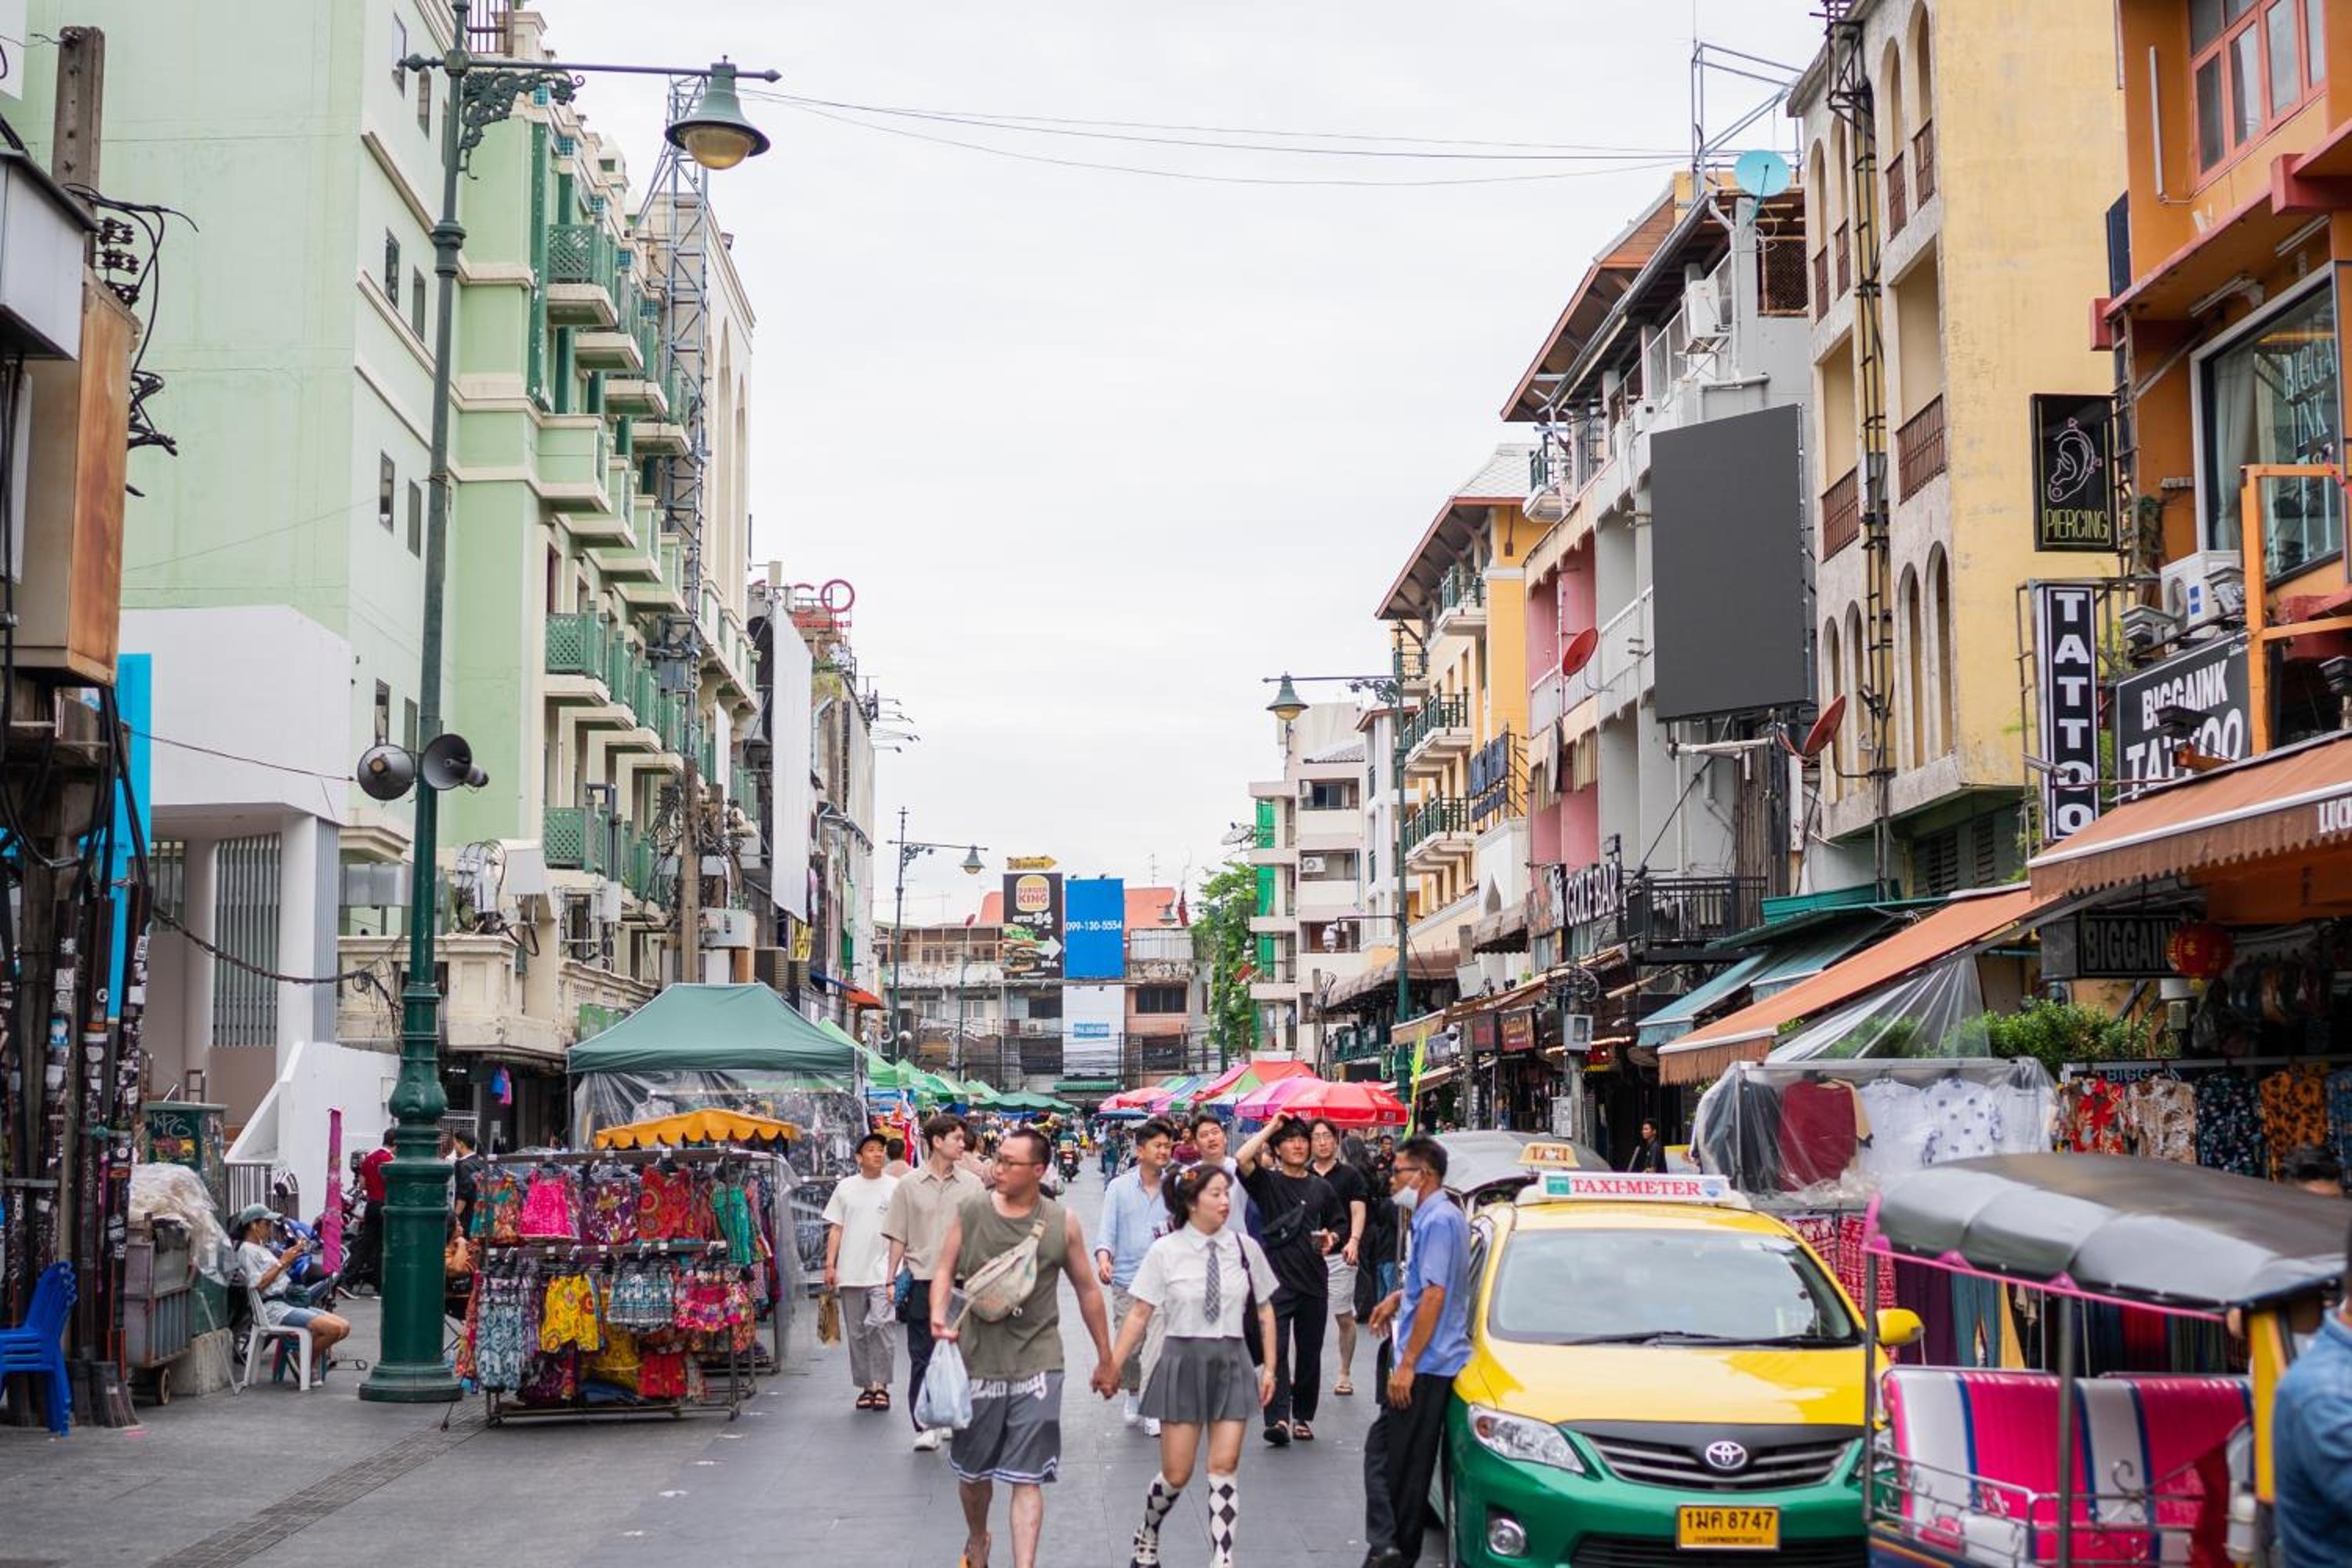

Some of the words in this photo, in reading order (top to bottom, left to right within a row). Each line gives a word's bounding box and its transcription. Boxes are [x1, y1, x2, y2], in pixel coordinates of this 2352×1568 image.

[2045, 509, 2108, 539] PIERCING
[2142, 659, 2228, 731] BIGGAINK
[2053, 592, 2093, 833] TATTOO
[1018, 894, 1047, 903] KING
[1033, 912, 1053, 925] 24
[1531, 1145, 1568, 1161] TAXI
[1571, 1179, 1701, 1196] TAXI-METER
[1728, 1511, 1773, 1530] 8747
